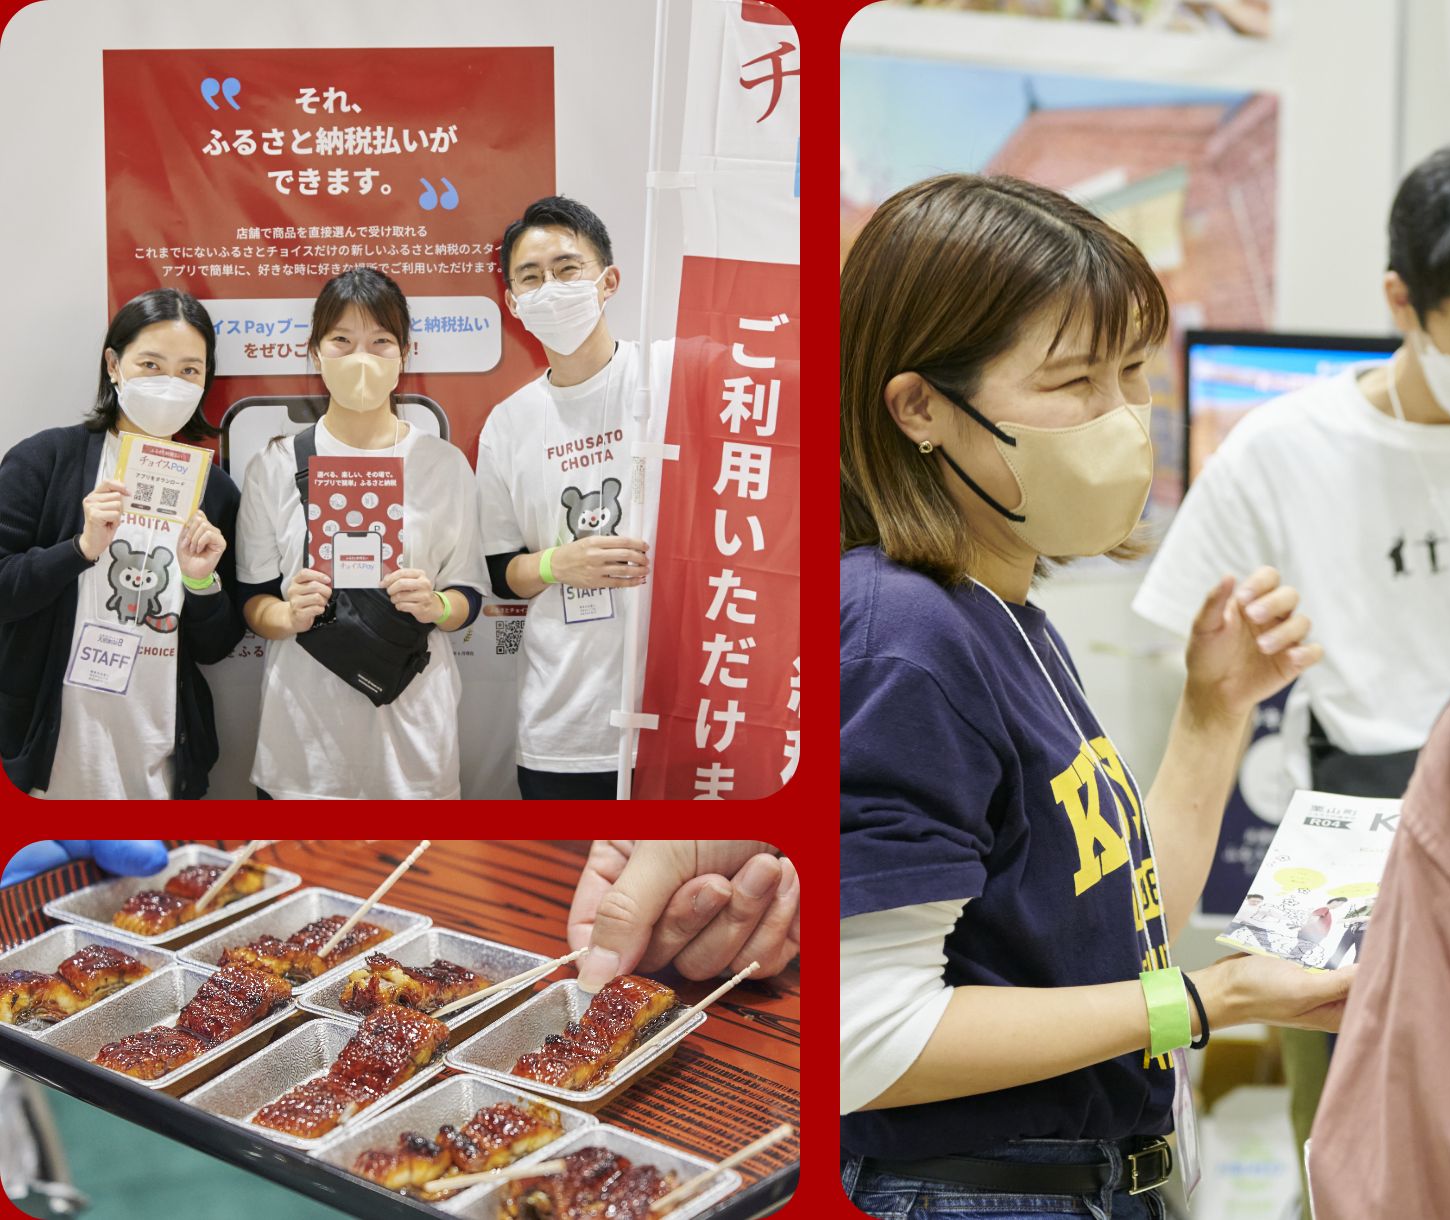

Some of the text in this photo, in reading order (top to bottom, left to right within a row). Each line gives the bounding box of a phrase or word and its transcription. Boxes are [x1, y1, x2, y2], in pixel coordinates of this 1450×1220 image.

[295, 87, 363, 115] それ、
[202, 125, 459, 156] ふるさと納税払いが
[267, 168, 393, 196] できます。
[236, 225, 428, 240] 店舗で商品を直接選んで受け取れる
[547, 429, 624, 460] FURUSATO
[561, 450, 614, 473] CHOITA
[692, 312, 791, 800] ご利用いただけま
[80, 646, 131, 670] STAFF
[1310, 818, 1341, 829] R04
